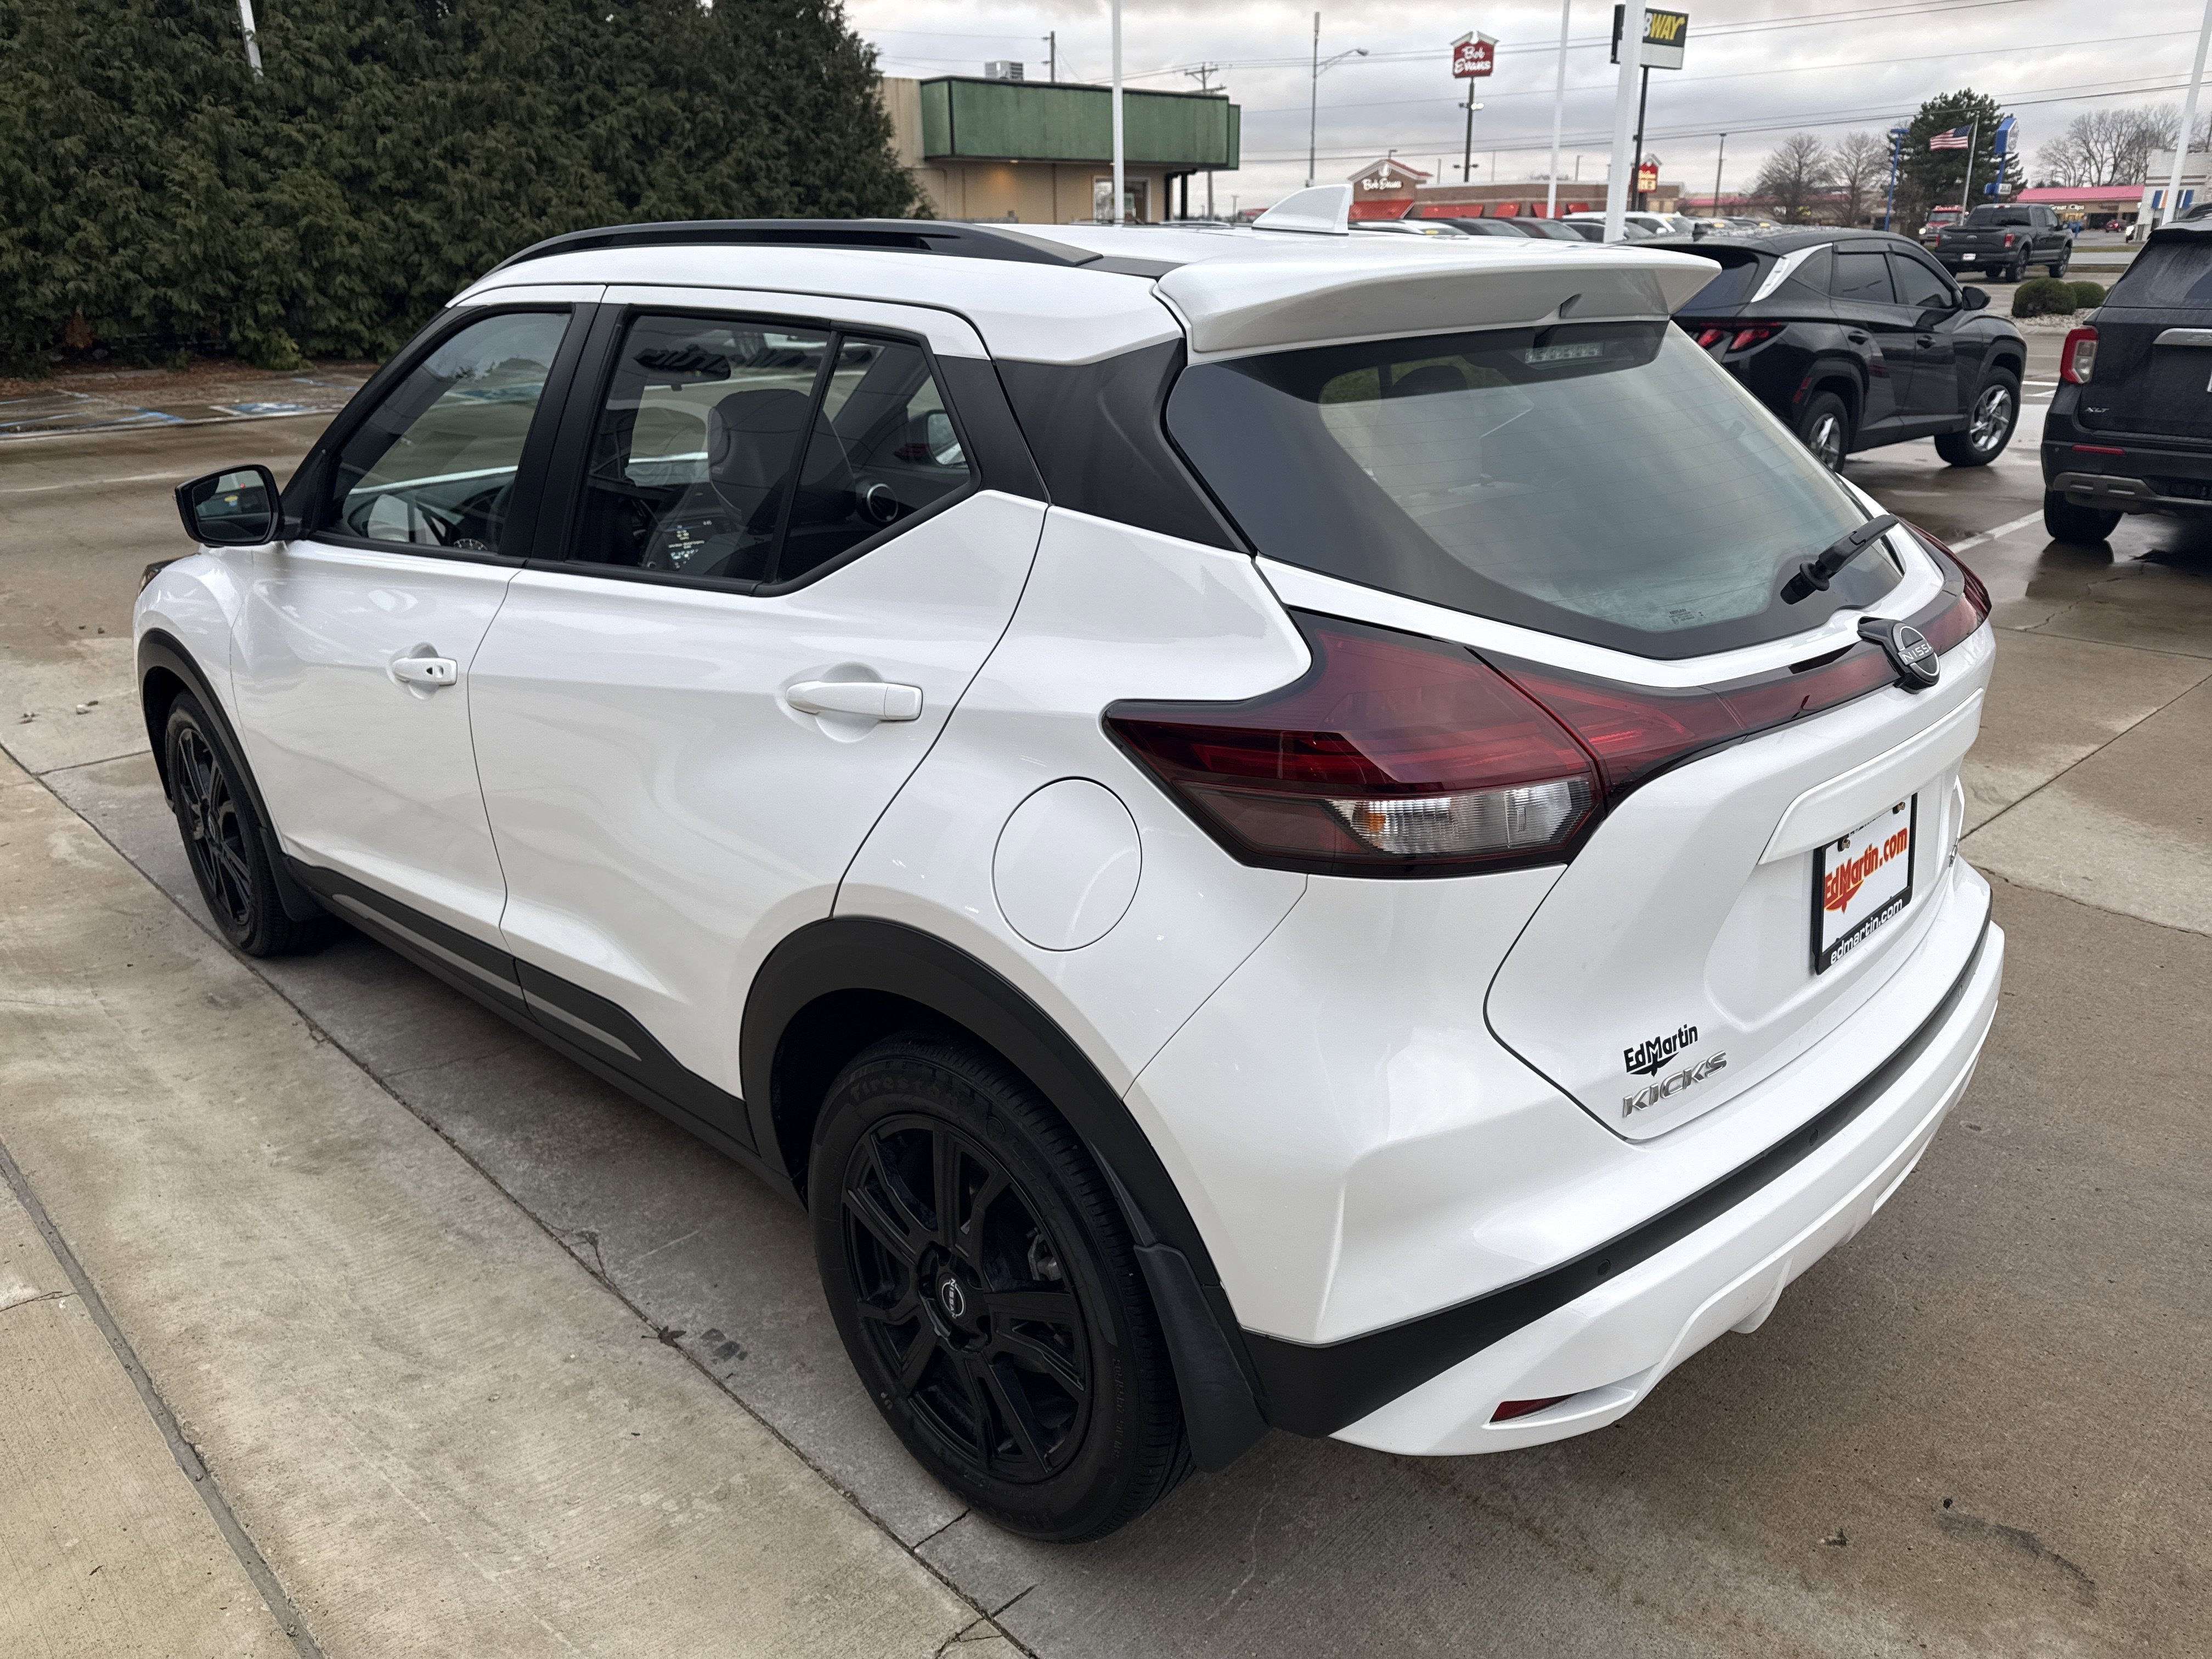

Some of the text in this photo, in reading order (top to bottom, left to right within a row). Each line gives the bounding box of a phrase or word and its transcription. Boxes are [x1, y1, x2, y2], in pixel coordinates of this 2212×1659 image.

[1643, 12, 1686, 40] BWAY
[1454, 58, 1491, 74] Evans
[1462, 46, 1486, 60] Bob
[1361, 178, 1379, 190] Bob
[1830, 898, 1903, 965] edmartin.com
[1623, 1024, 1698, 1074] EdMartin
[1622, 1051, 1727, 1118] KICKS
